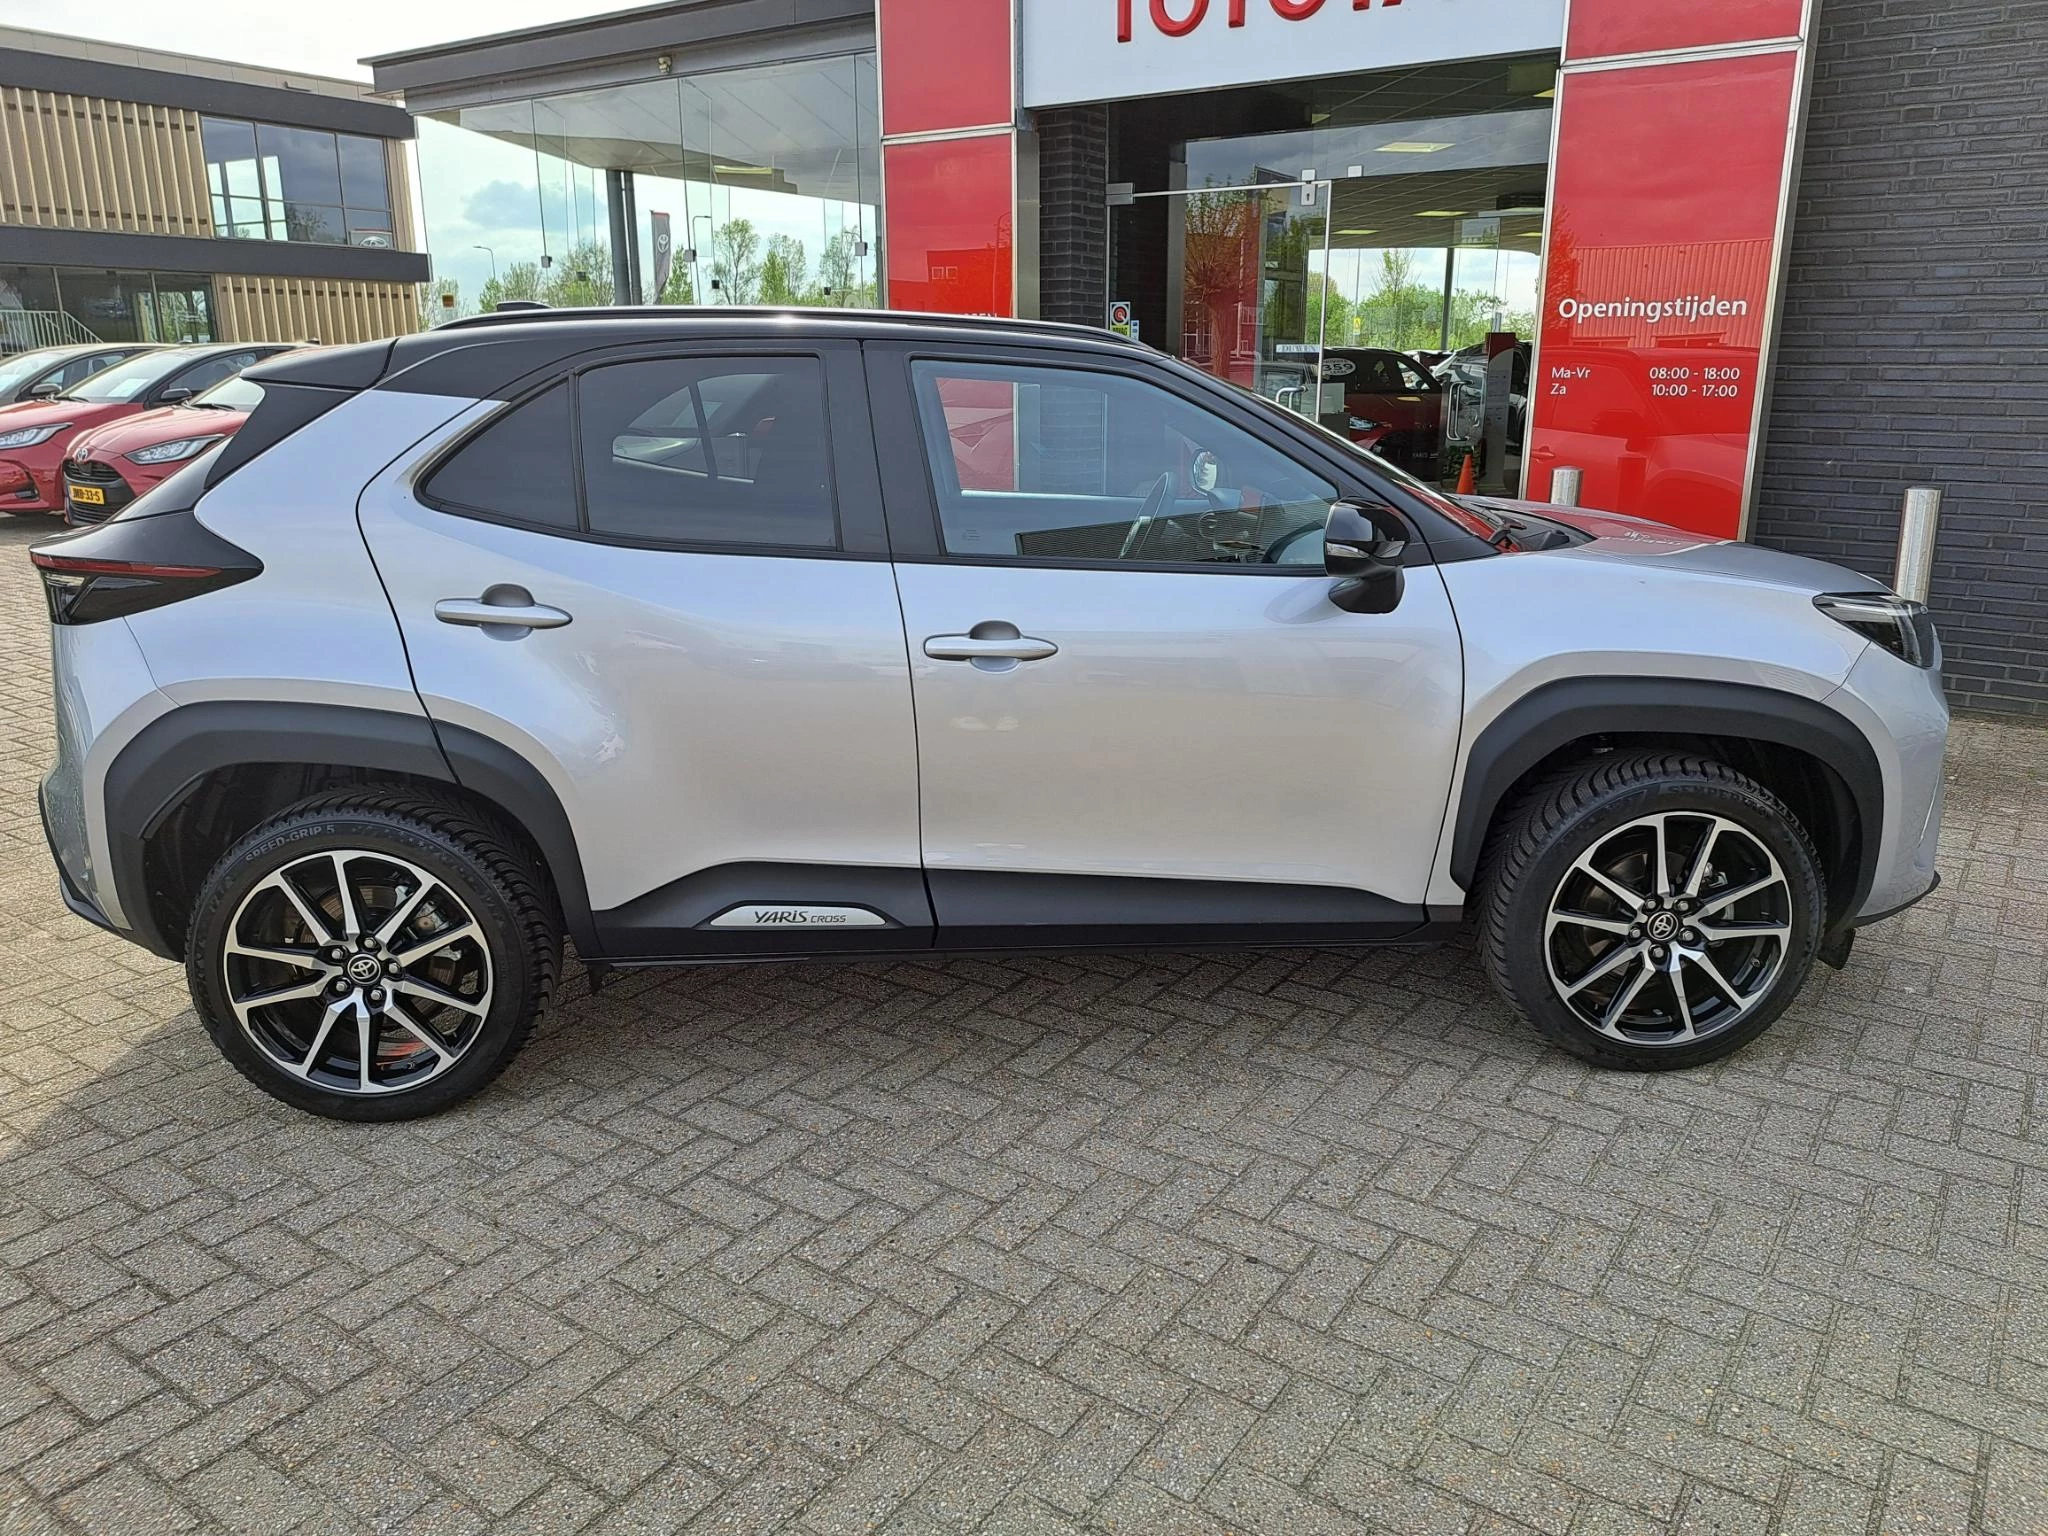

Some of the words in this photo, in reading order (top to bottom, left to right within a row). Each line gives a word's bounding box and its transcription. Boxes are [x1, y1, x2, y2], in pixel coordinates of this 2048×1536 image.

[1558, 295, 1748, 324] Openingstijden
[1551, 367, 1591, 379] Ma-Vr
[1649, 367, 1689, 380] 08:00
[1703, 367, 1740, 380] 18:00
[1550, 383, 1567, 395] Za
[1652, 384, 1688, 397] 10:00
[1702, 384, 1738, 397] 17:00
[245, 826, 322, 862] SPEED-GRIP
[326, 824, 335, 833] 5
[810, 914, 847, 924] CROSS
